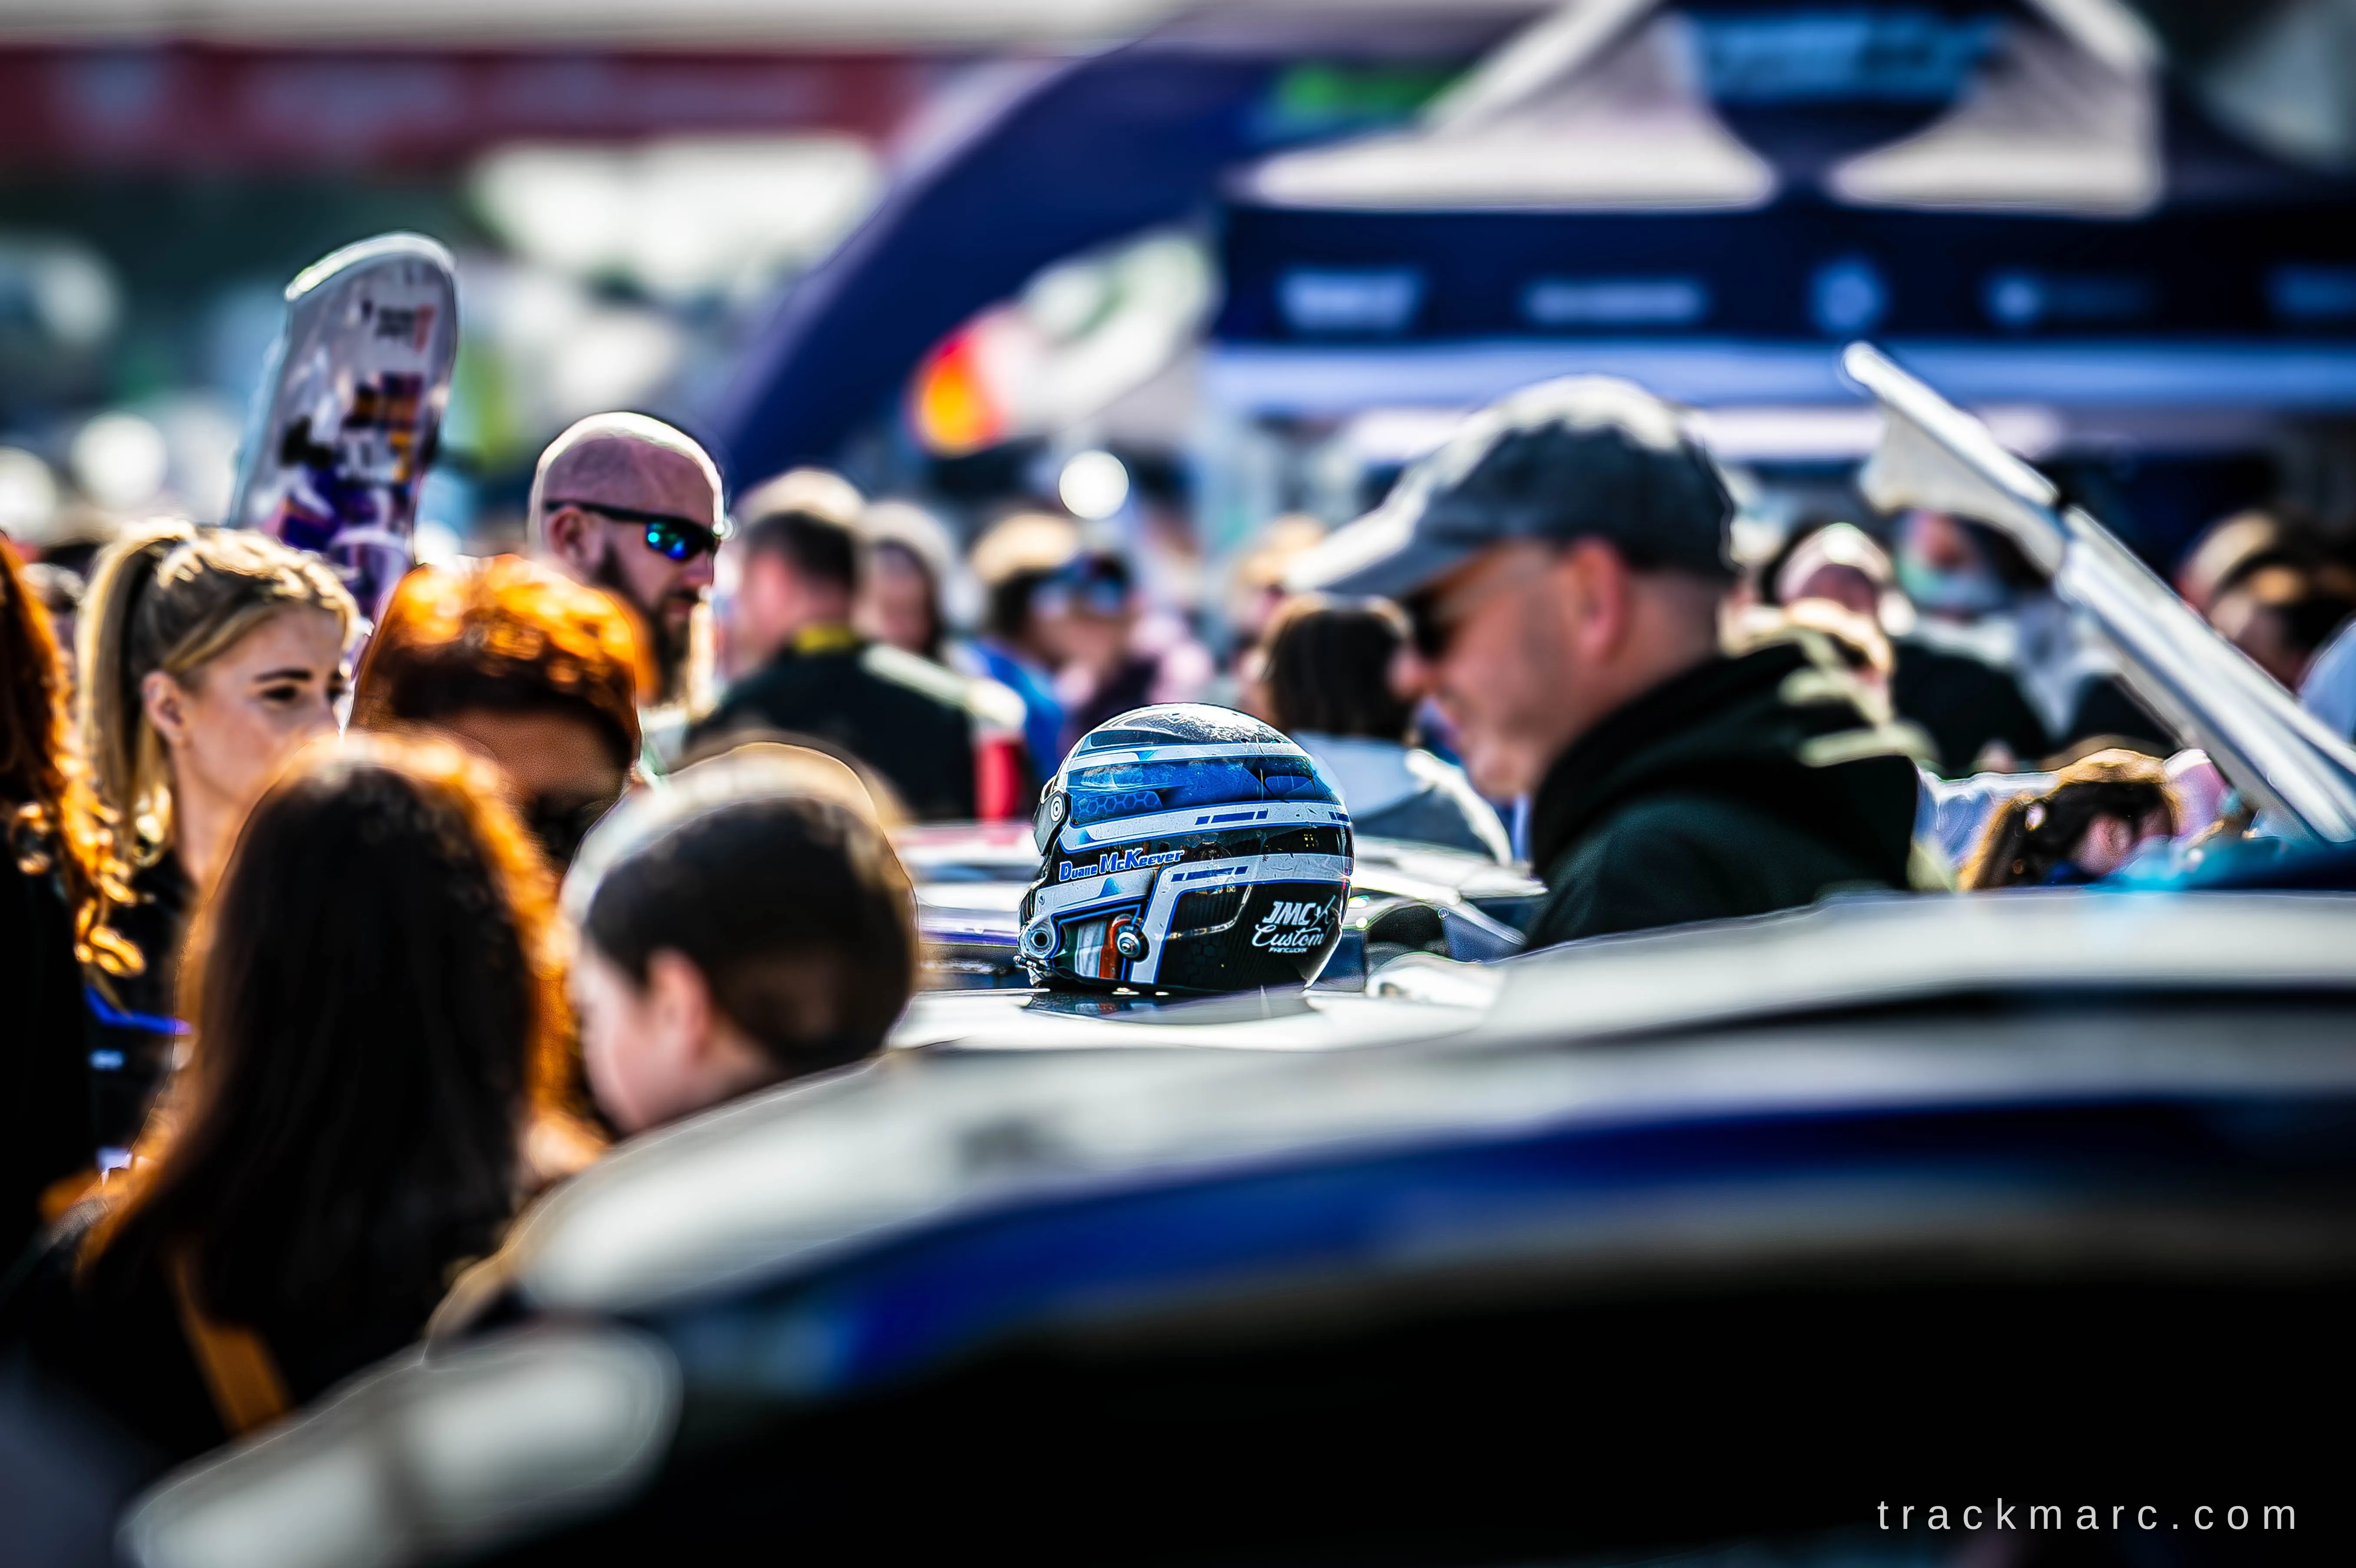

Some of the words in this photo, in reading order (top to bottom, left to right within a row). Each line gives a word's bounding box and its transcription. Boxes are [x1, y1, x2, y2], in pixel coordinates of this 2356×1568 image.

[1059, 861, 1098, 881] Duane
[1099, 848, 1185, 874] McKeever
[1262, 901, 1317, 925] JMC
[1252, 924, 1324, 946] Custom
